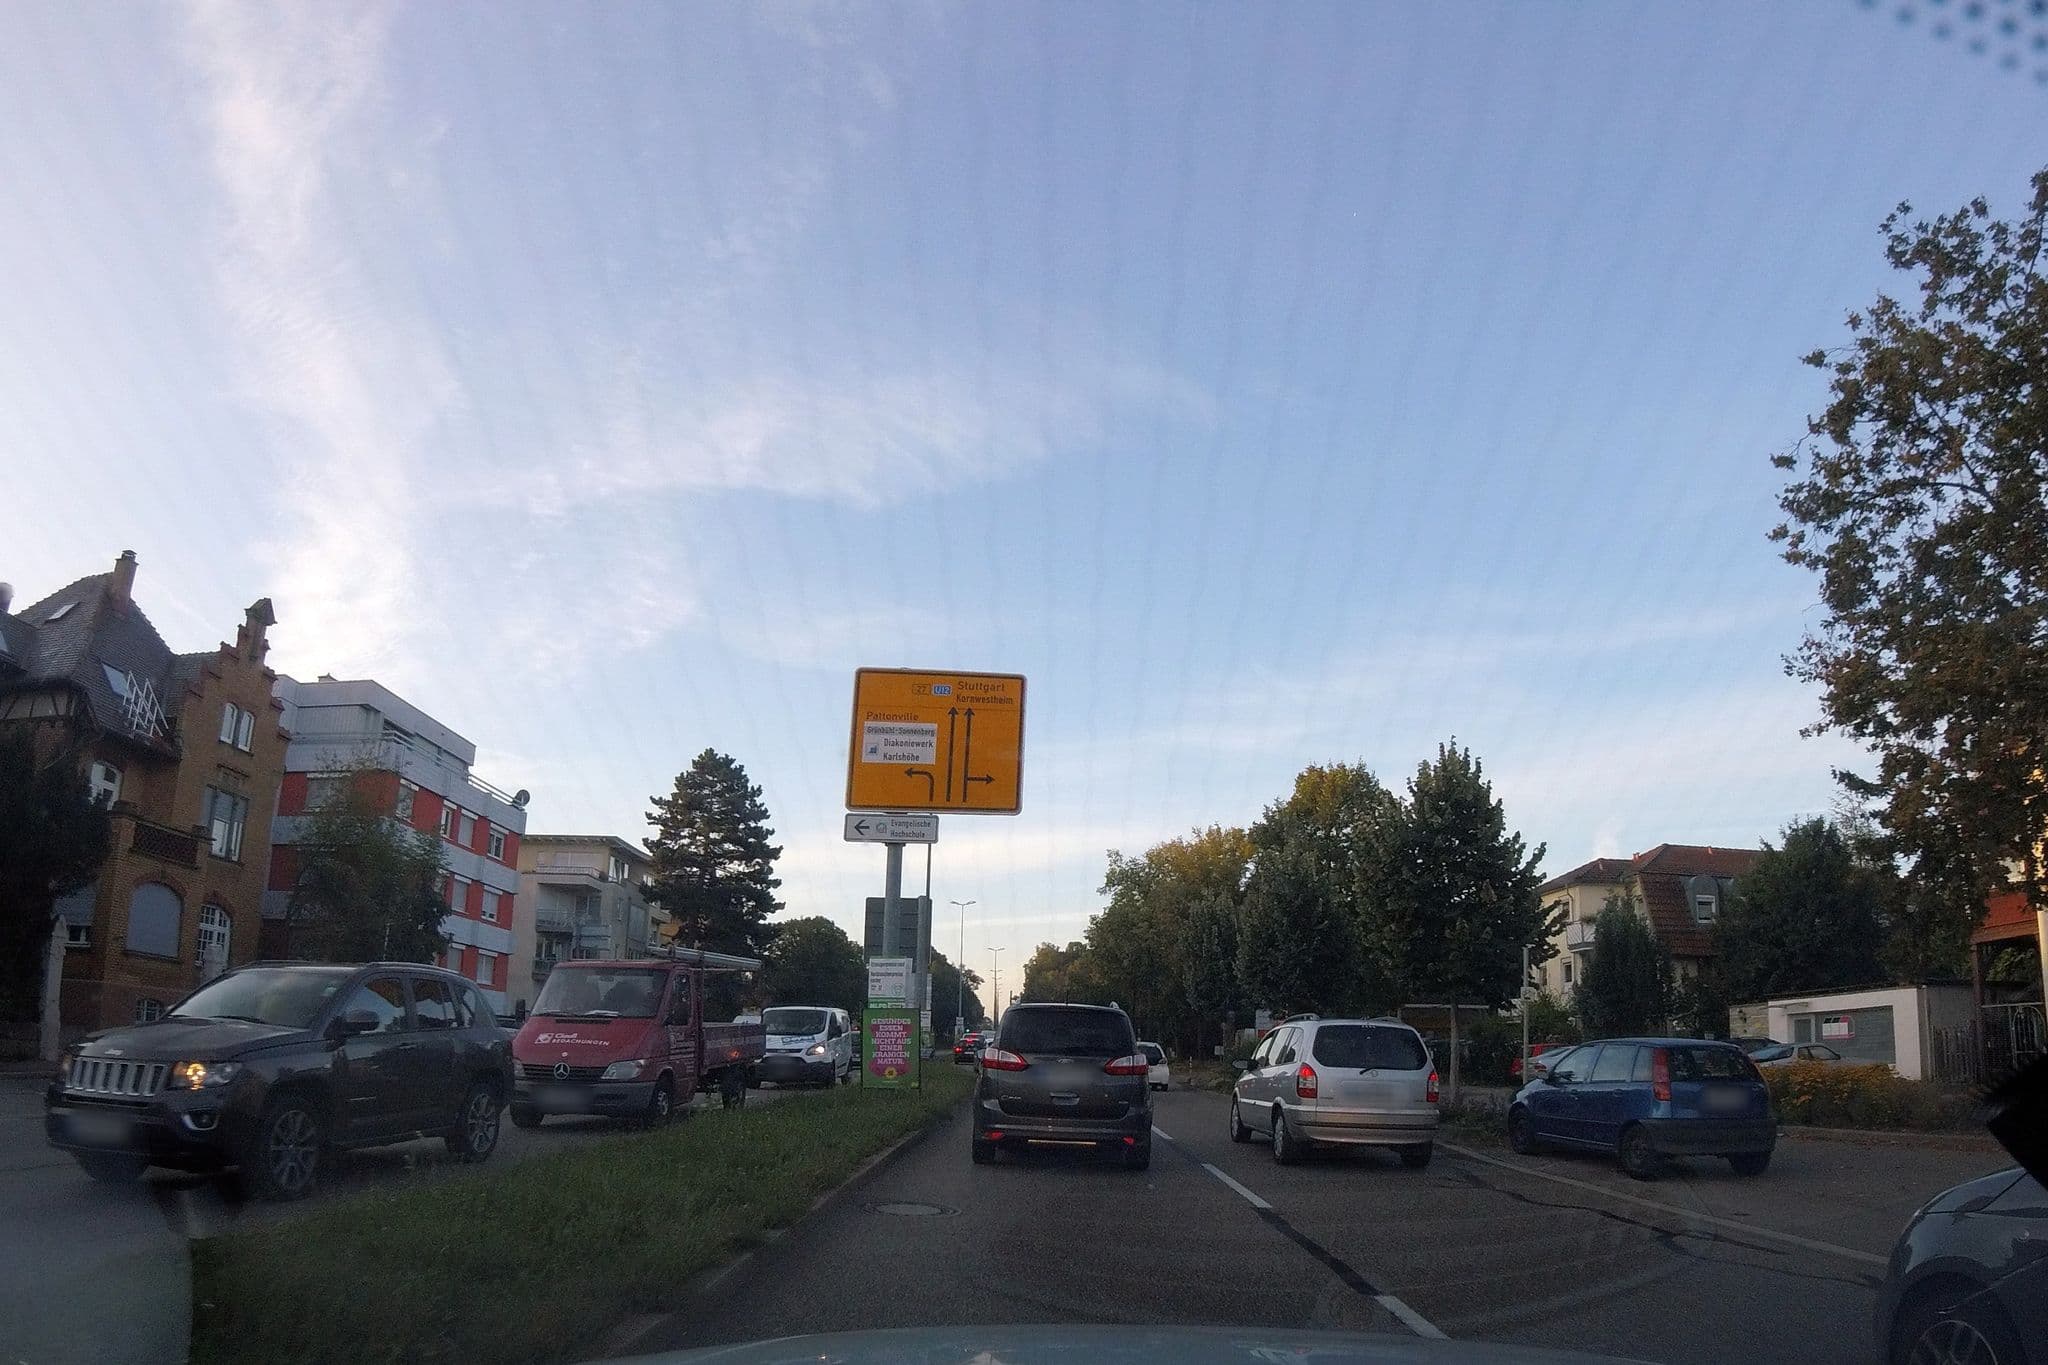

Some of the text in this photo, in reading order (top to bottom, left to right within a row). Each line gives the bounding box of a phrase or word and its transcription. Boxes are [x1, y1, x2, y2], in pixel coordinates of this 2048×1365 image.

[958, 681, 1005, 692] Stuttgart
[956, 694, 1014, 705] Kornwestheim
[866, 711, 919, 720] Pattonville
[884, 738, 934, 748] Diakoniewerk
[883, 752, 920, 761] Karlshöhe
[890, 819, 931, 828] Evangelische
[890, 829, 926, 838] Hochschule
